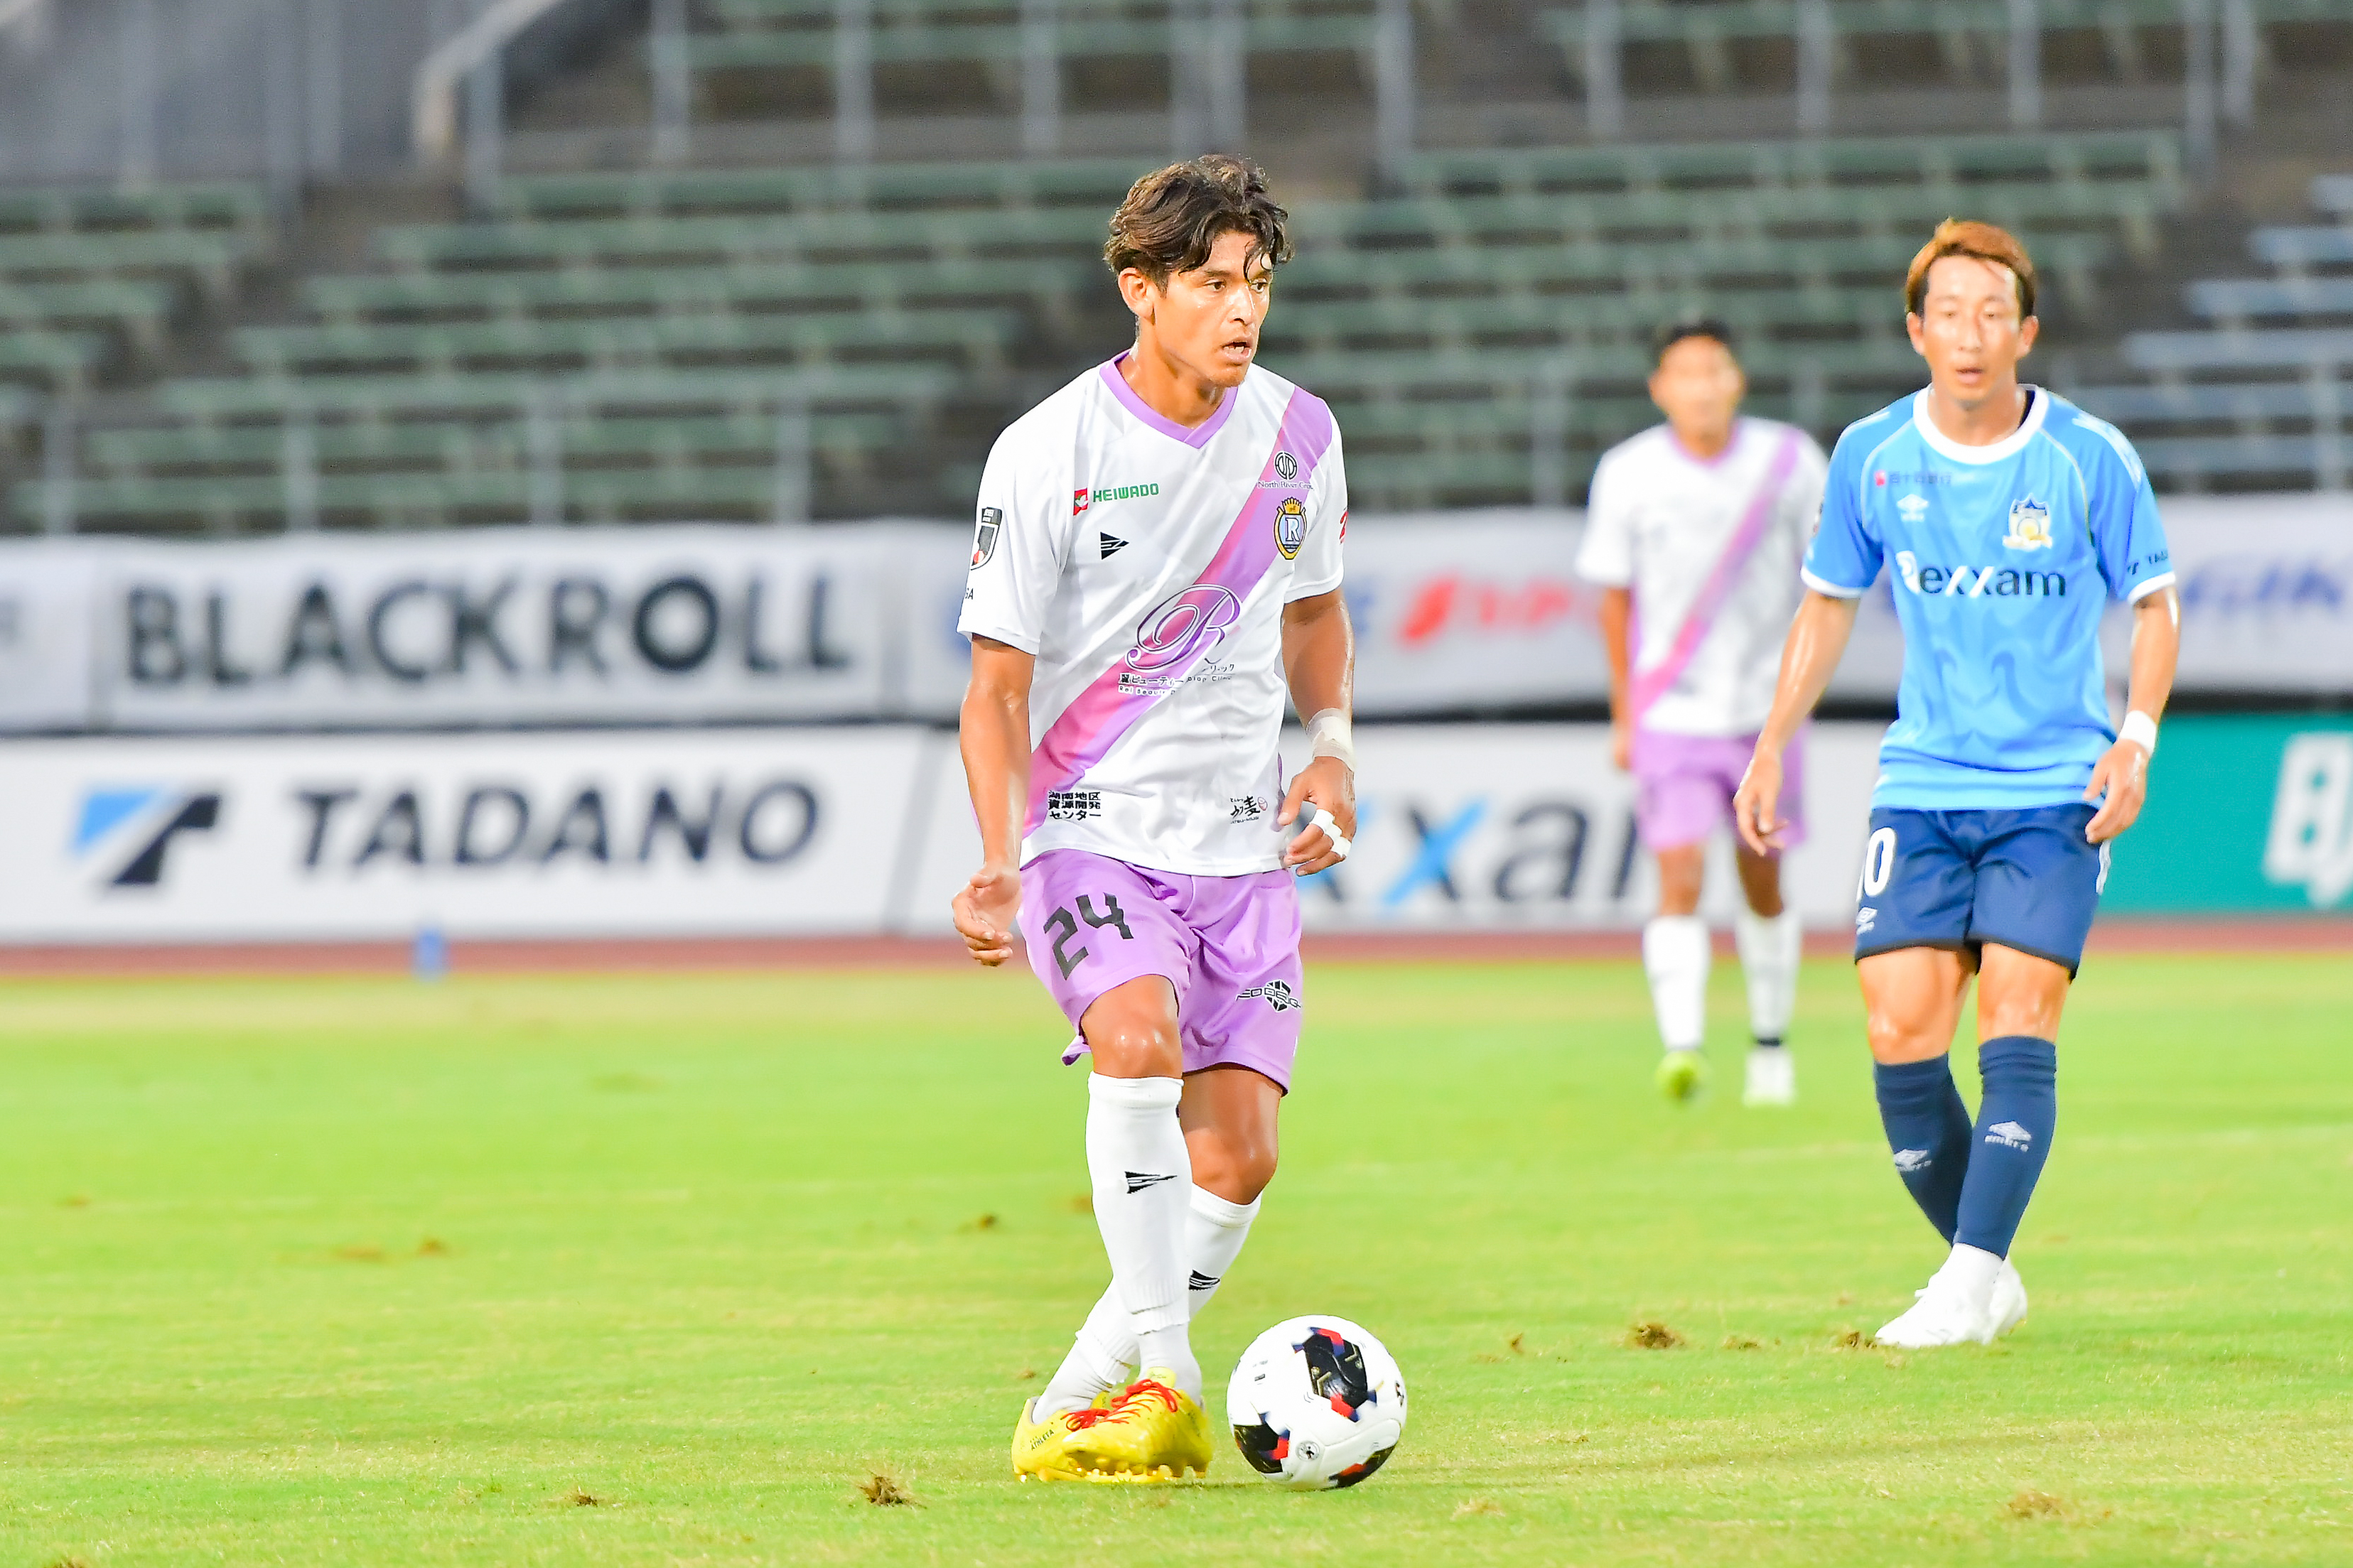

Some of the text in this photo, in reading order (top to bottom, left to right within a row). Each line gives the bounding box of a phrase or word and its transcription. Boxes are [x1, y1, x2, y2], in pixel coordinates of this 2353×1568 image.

[1093, 483, 1159, 502] HEIWADO
[1299, 481, 1315, 491] Grou
[1285, 518, 1300, 541] R
[126, 572, 851, 685] BLACKROLL
[293, 782, 819, 867] TADANO
[1049, 810, 1102, 821] センター
[1043, 892, 1134, 980] 24
